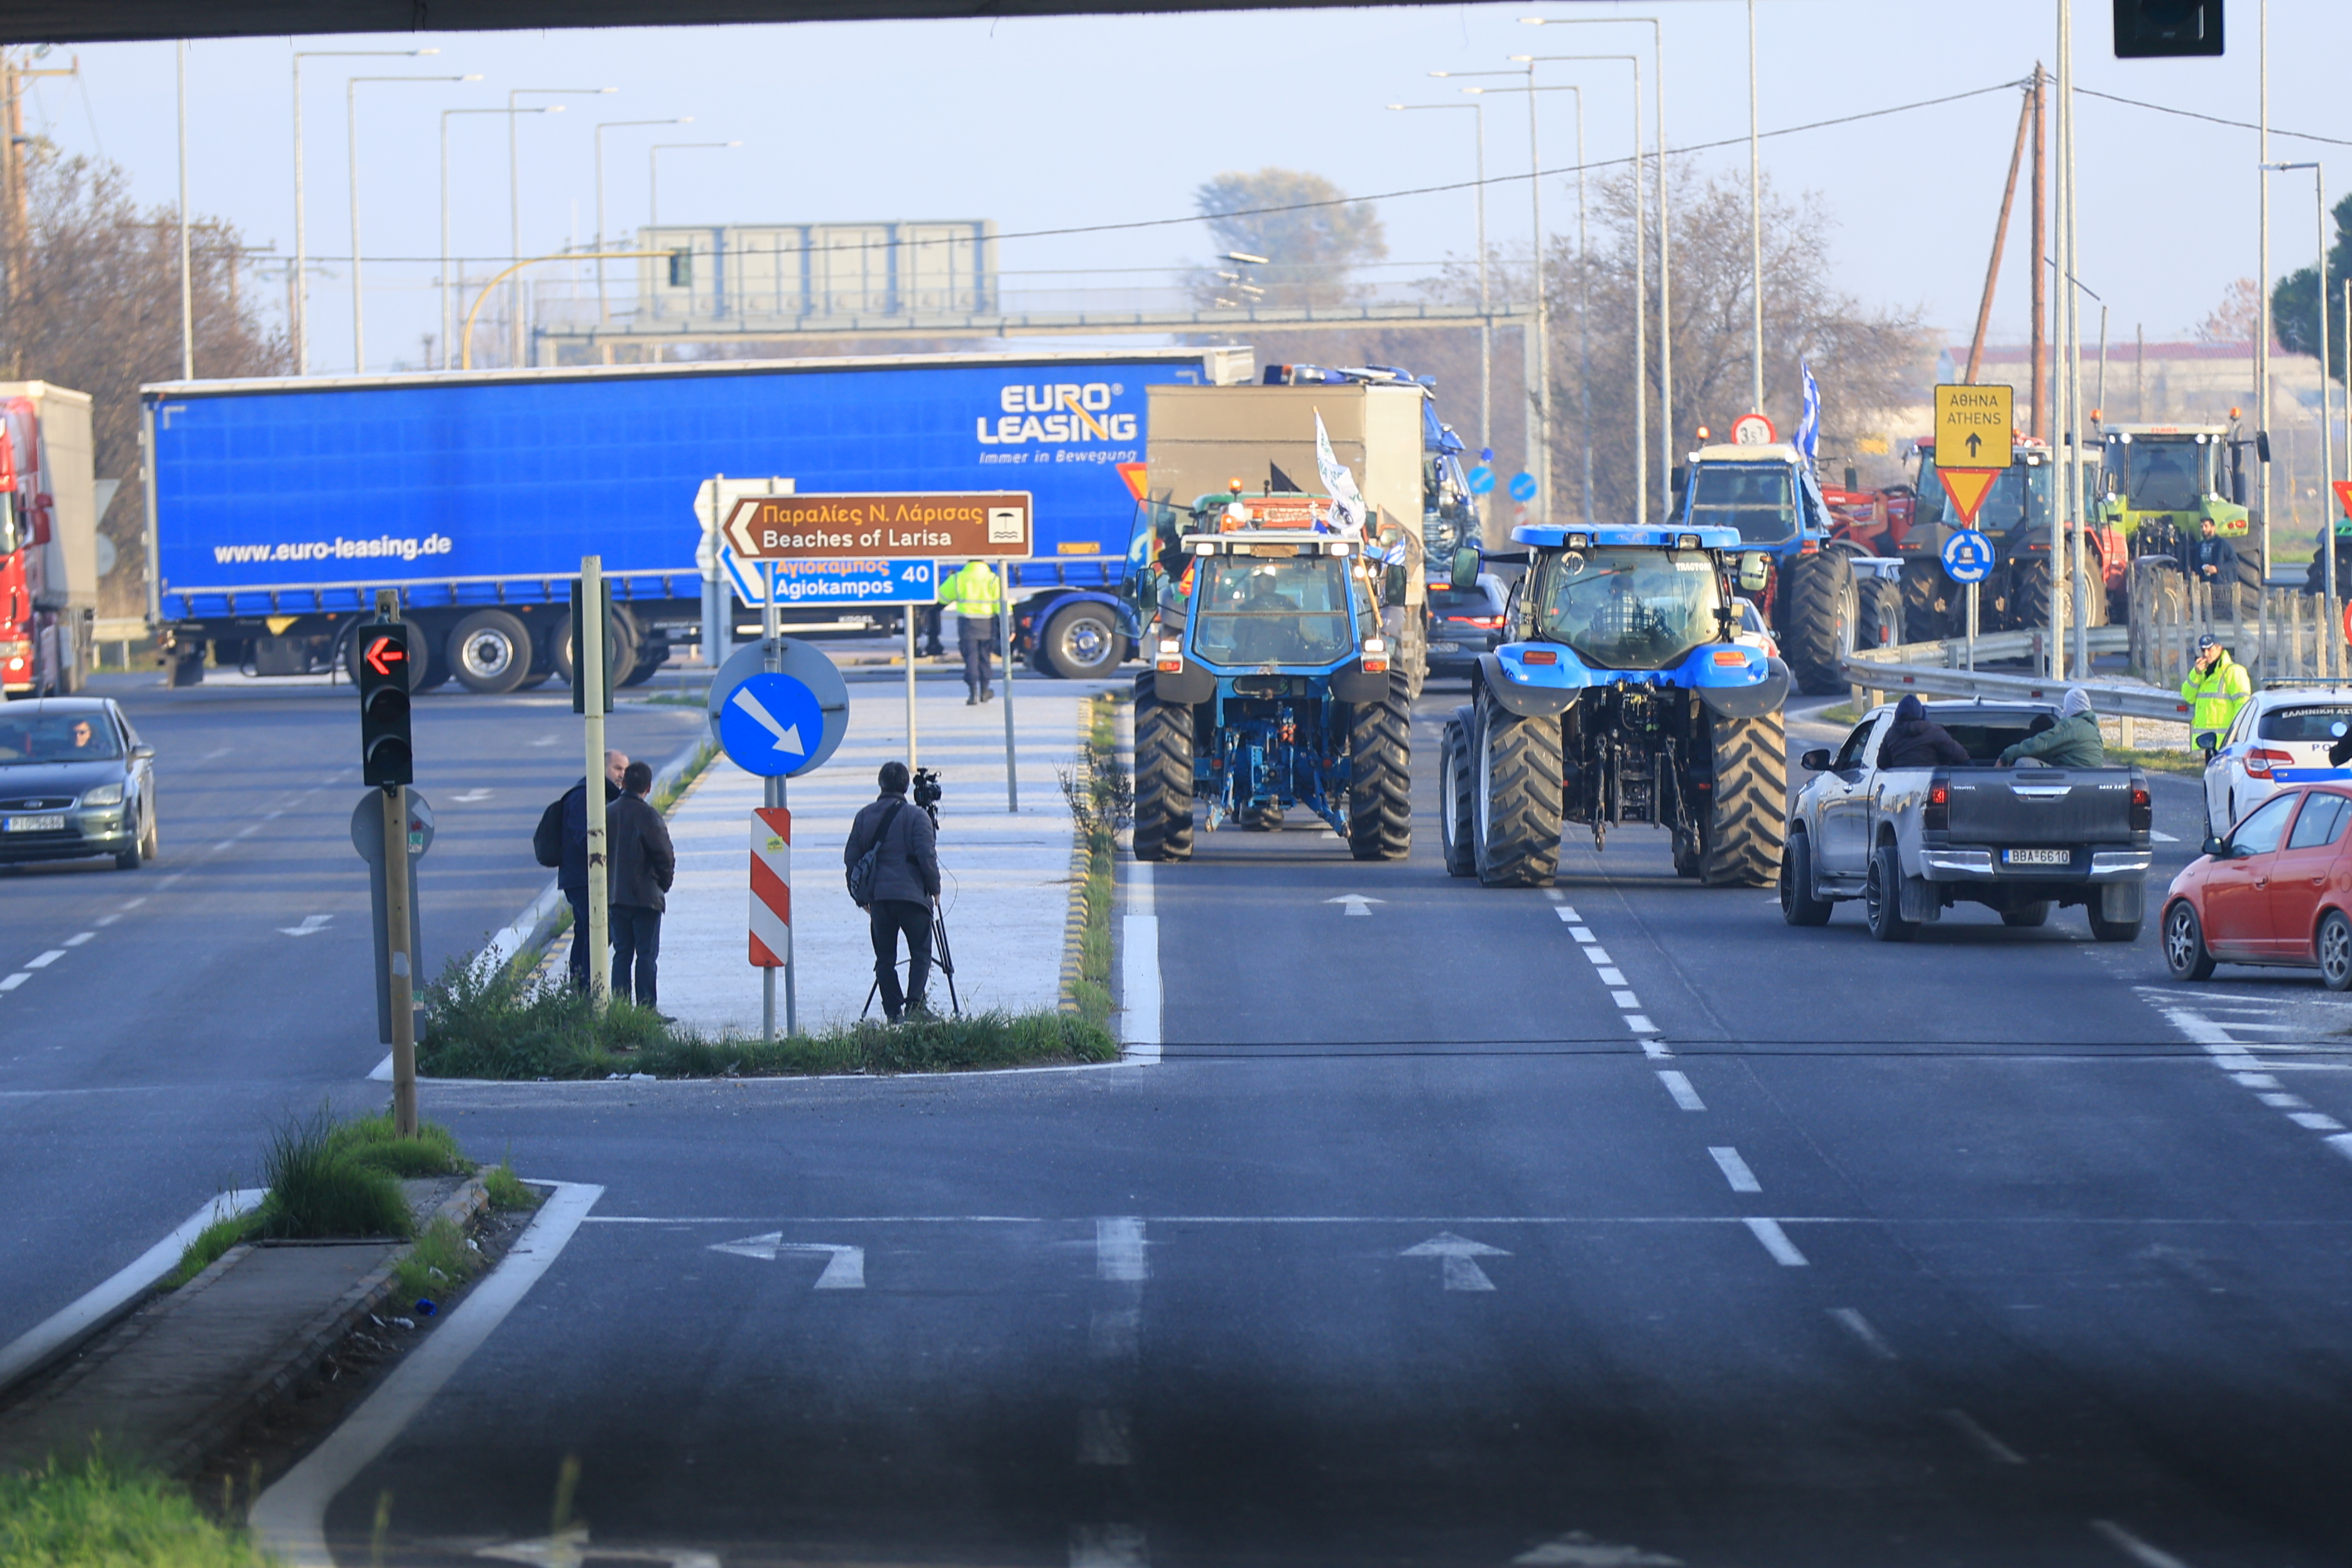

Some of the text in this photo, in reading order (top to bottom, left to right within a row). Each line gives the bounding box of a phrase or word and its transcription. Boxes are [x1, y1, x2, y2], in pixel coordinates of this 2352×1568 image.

[1950, 394, 1998, 406] ΑΘΗΝΑ
[1947, 412, 2001, 425] ATHENS
[976, 413, 1138, 444] LEASING
[979, 450, 1137, 464] Immer in Bewegung
[763, 504, 863, 527] Παραλίες
[895, 503, 984, 525] Λάρισας
[763, 528, 952, 548] Beaches of Larisa
[214, 533, 453, 564] www.euro-leasing.de
[901, 565, 930, 583] 40
[776, 578, 893, 599] Agiokampos
[2282, 708, 2334, 719] ΕΛΛΗΝΙΚΗ
